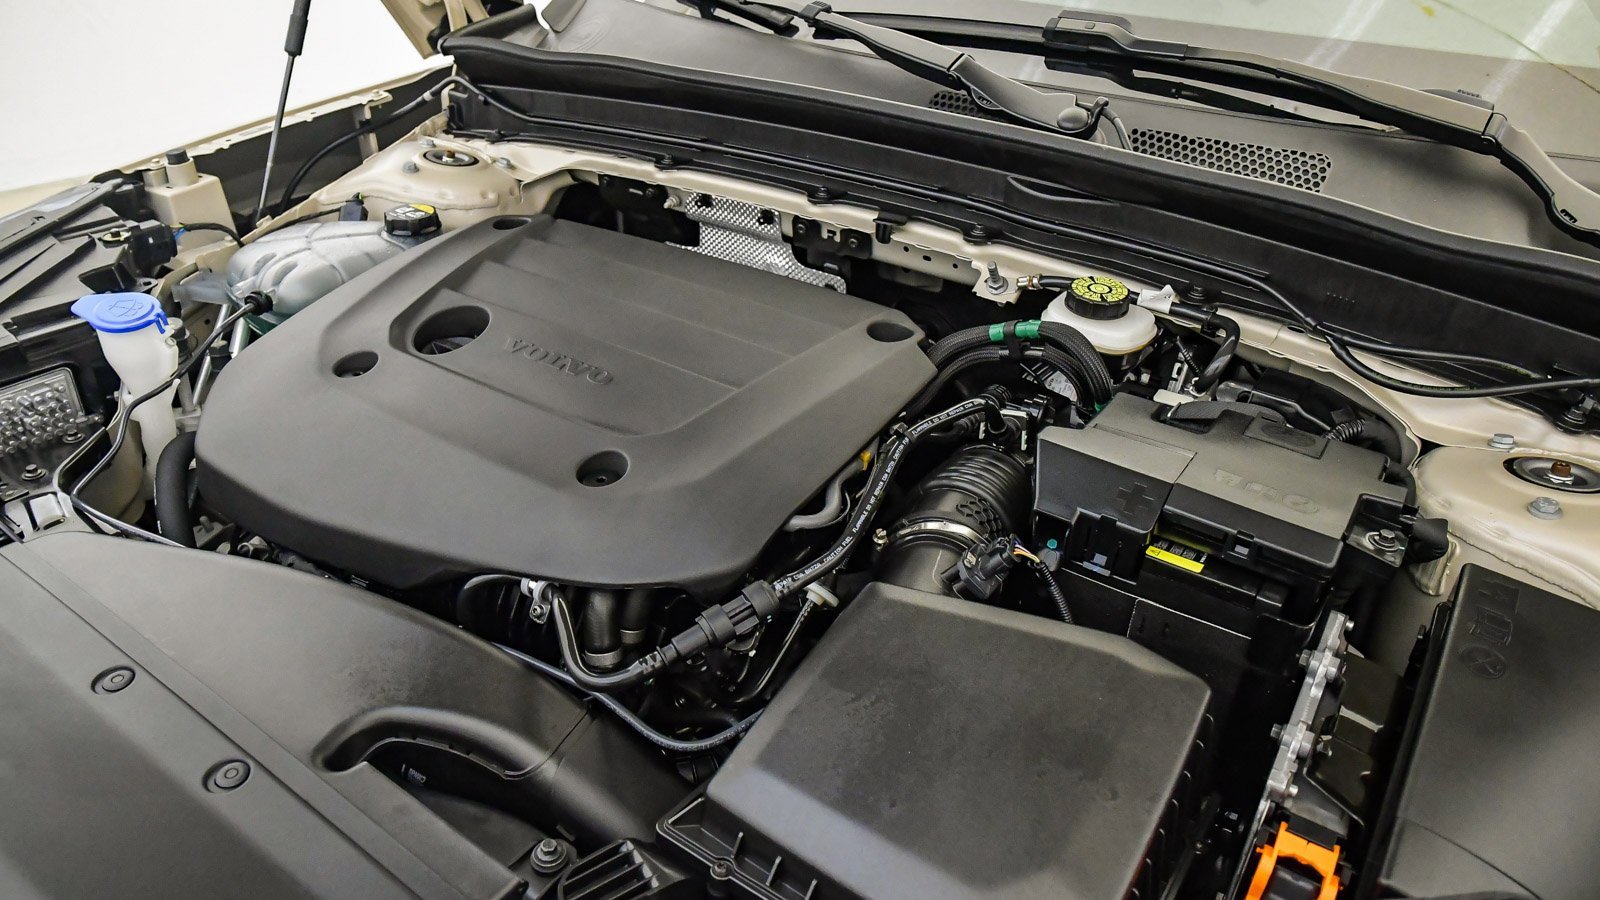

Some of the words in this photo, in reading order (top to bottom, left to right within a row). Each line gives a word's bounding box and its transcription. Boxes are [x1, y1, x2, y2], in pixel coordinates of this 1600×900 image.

[504, 336, 614, 385] VOLVO
[823, 546, 844, 562] CAUTION
[841, 536, 853, 547] FUEL
[892, 444, 904, 460] CAUTION
